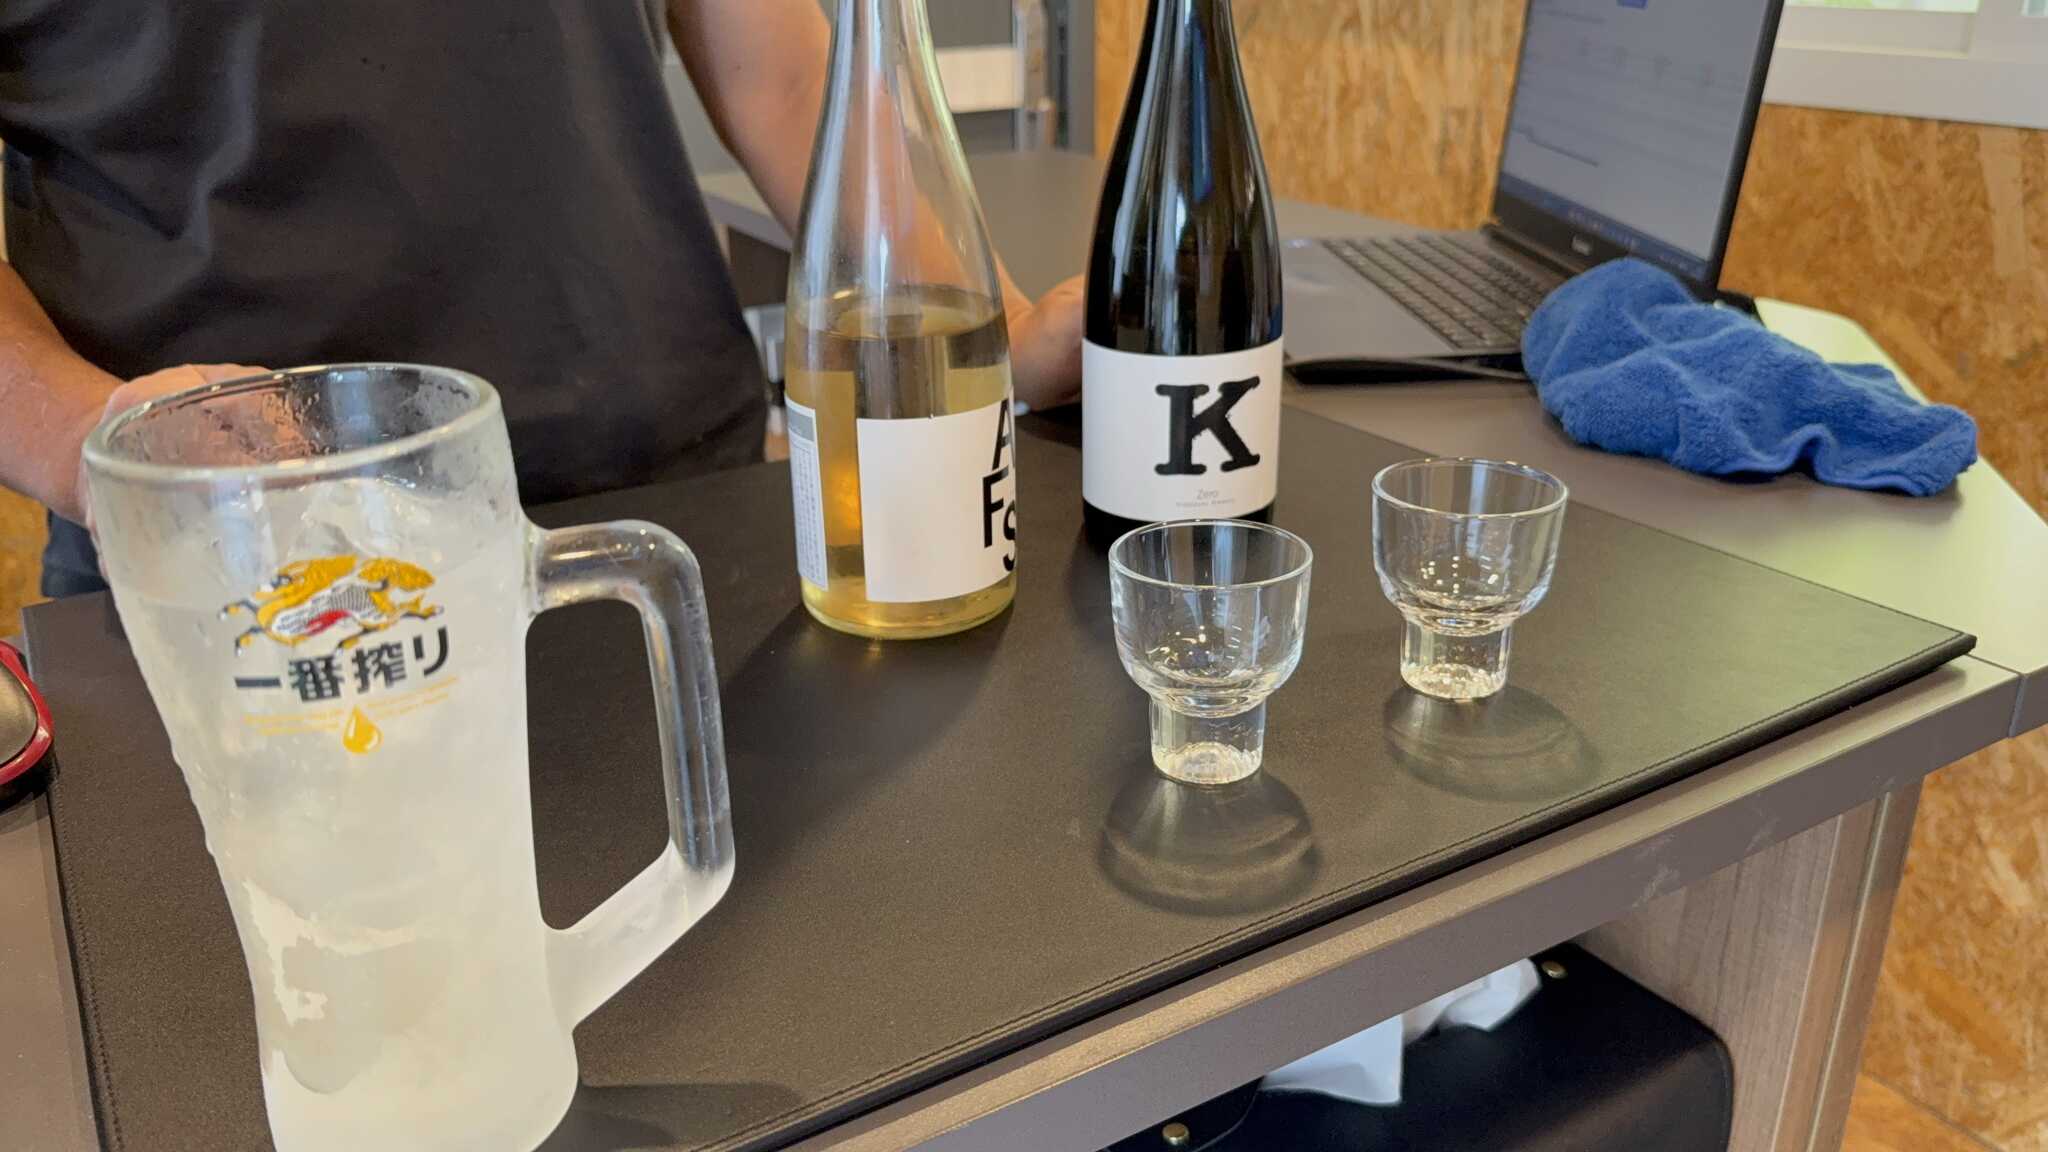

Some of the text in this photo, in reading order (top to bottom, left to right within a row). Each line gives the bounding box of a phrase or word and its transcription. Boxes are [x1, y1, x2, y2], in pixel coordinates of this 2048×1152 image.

[1155, 376, 1260, 475] K
[234, 627, 449, 702] 一番搾り
